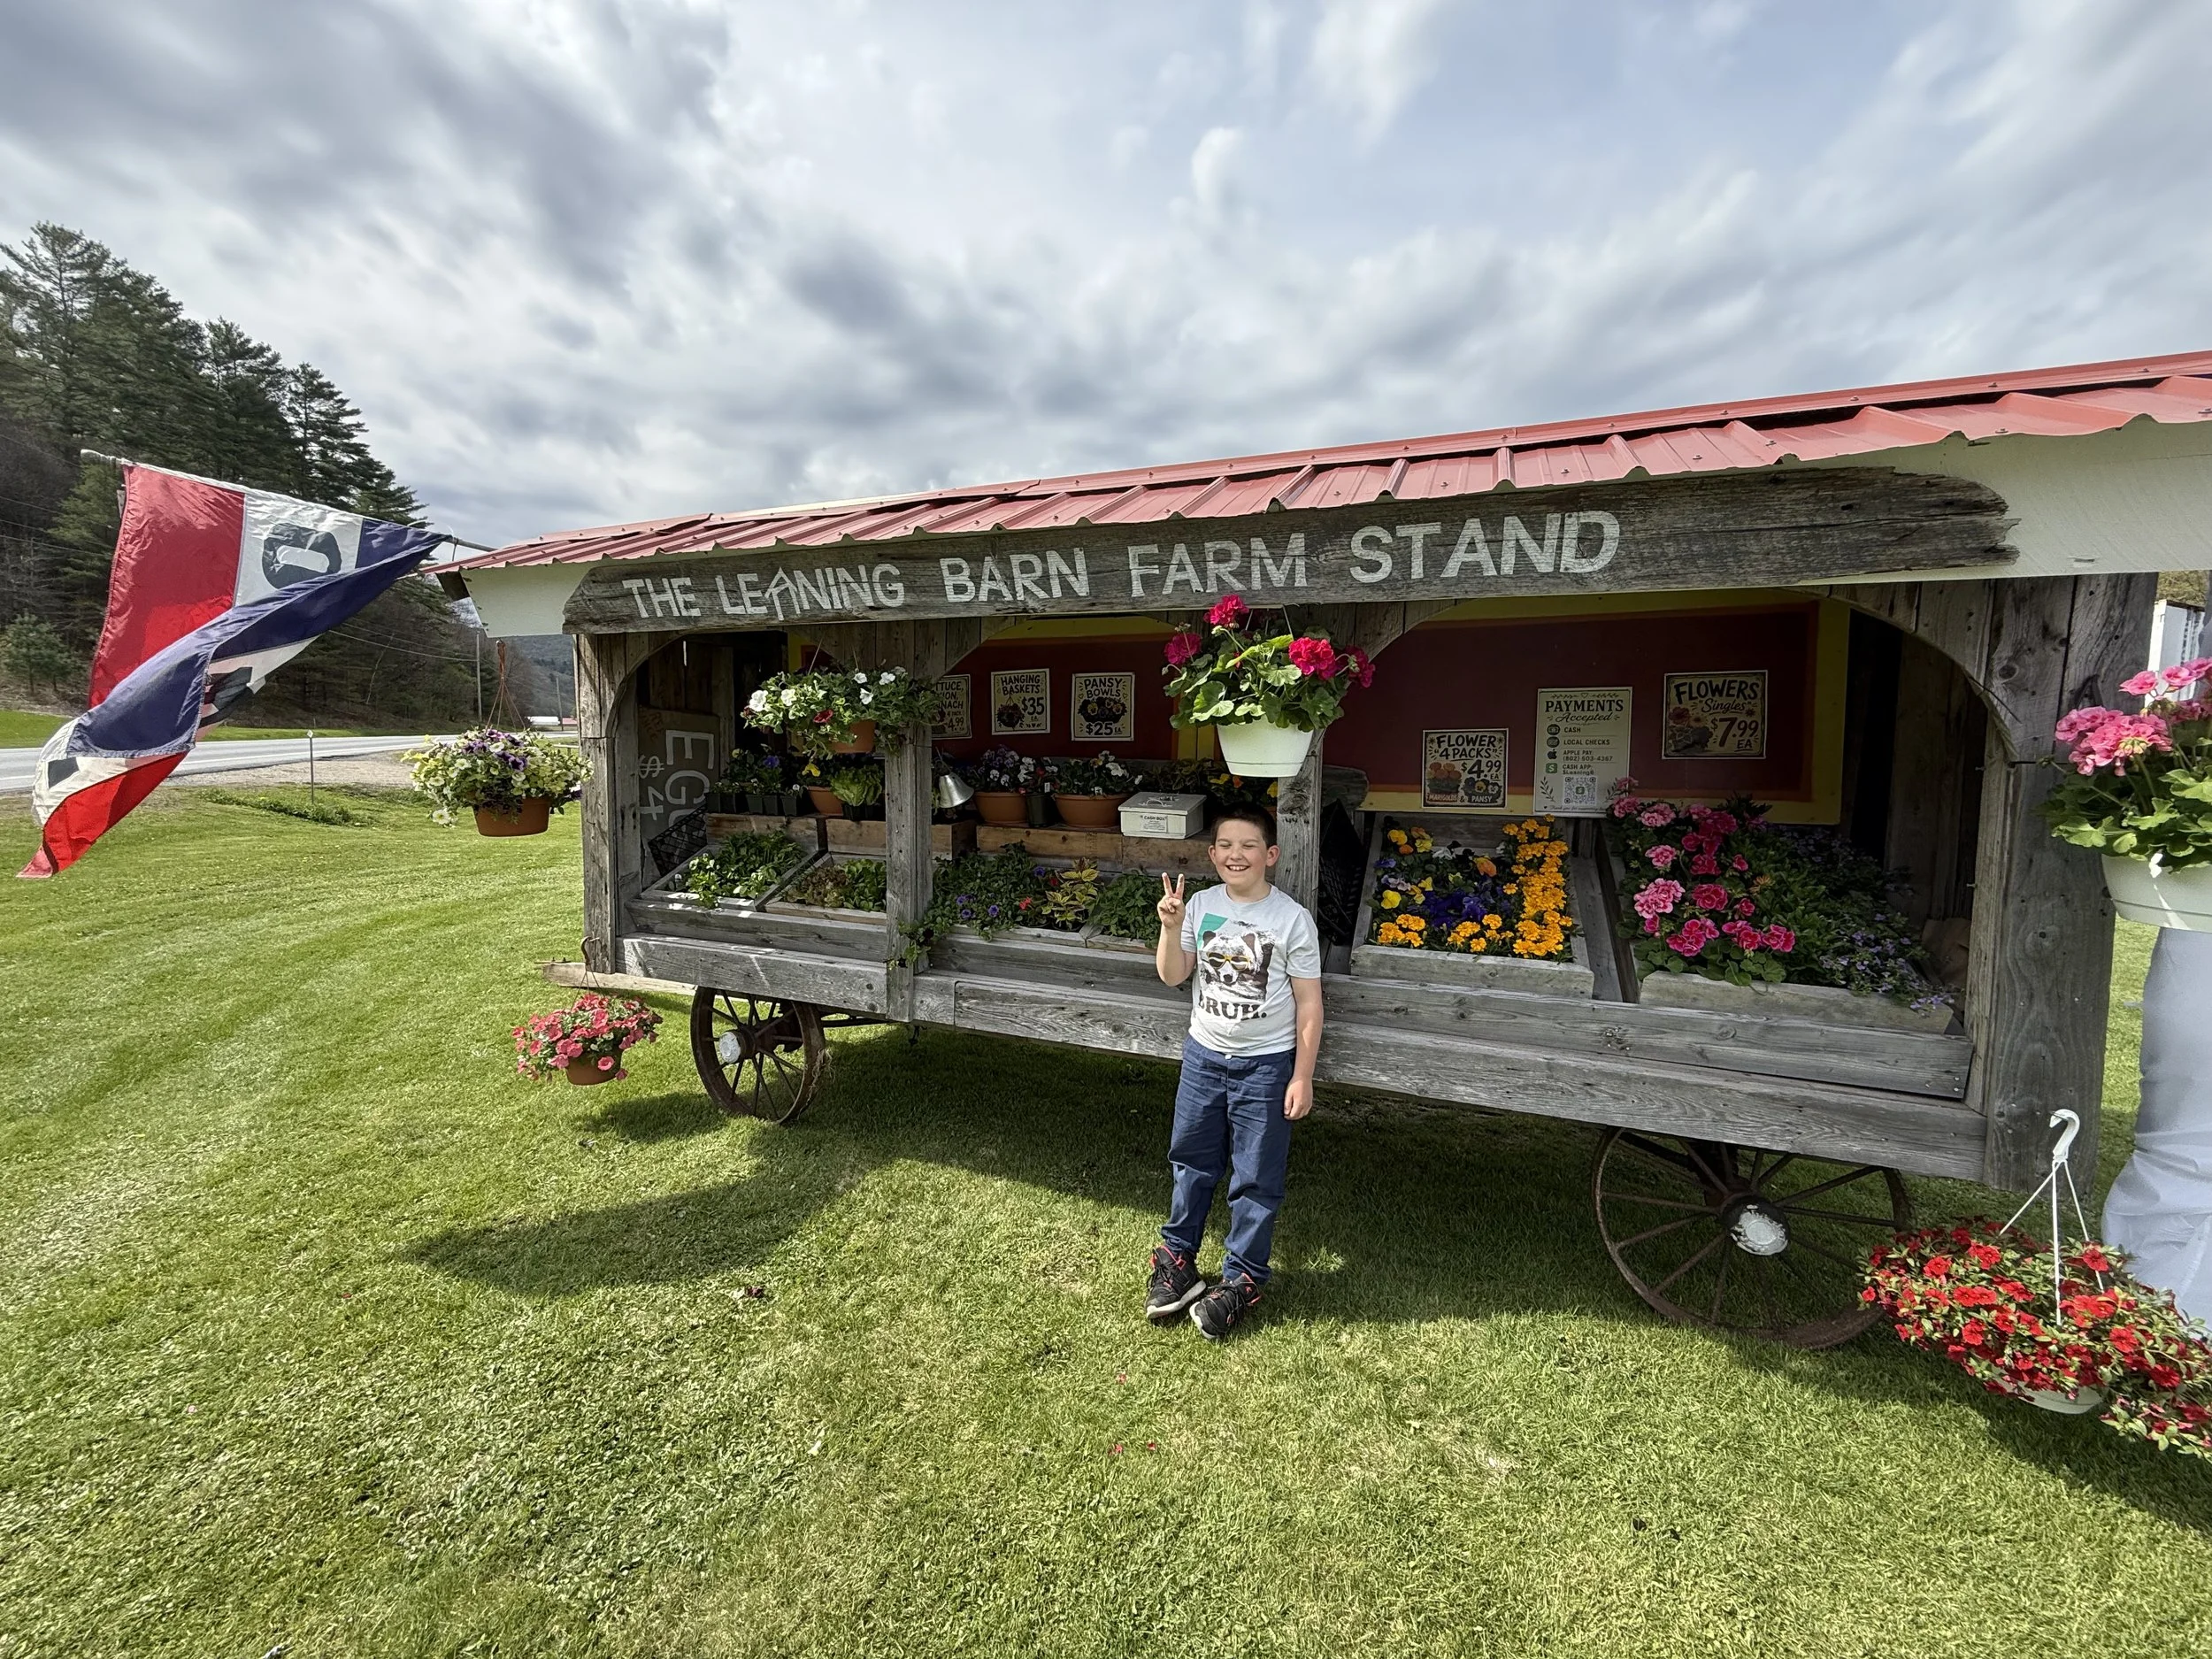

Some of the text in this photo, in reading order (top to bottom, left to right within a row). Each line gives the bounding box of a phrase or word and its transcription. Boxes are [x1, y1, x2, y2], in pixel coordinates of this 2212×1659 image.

[622, 511, 1620, 621] THE LEANING BARN FARM STAND
[935, 680, 964, 693] TTUCE,
[1001, 675, 1041, 687] HANGING
[1084, 678, 1123, 690] PANSY
[1002, 684, 1041, 695] BASKETS
[1087, 688, 1121, 698] BOWLS
[1674, 679, 1759, 704] FLOWERS
[1021, 696, 1044, 715] $35
[1545, 699, 1624, 712] PAYMENTS
[1555, 711, 1613, 723] Accepted
[1086, 722, 1113, 735] $25
[1710, 717, 1759, 747] $7.99
[1436, 735, 1496, 749] FLOWER
[1737, 739, 1753, 749] EA
[1461, 759, 1502, 779] $4.99
